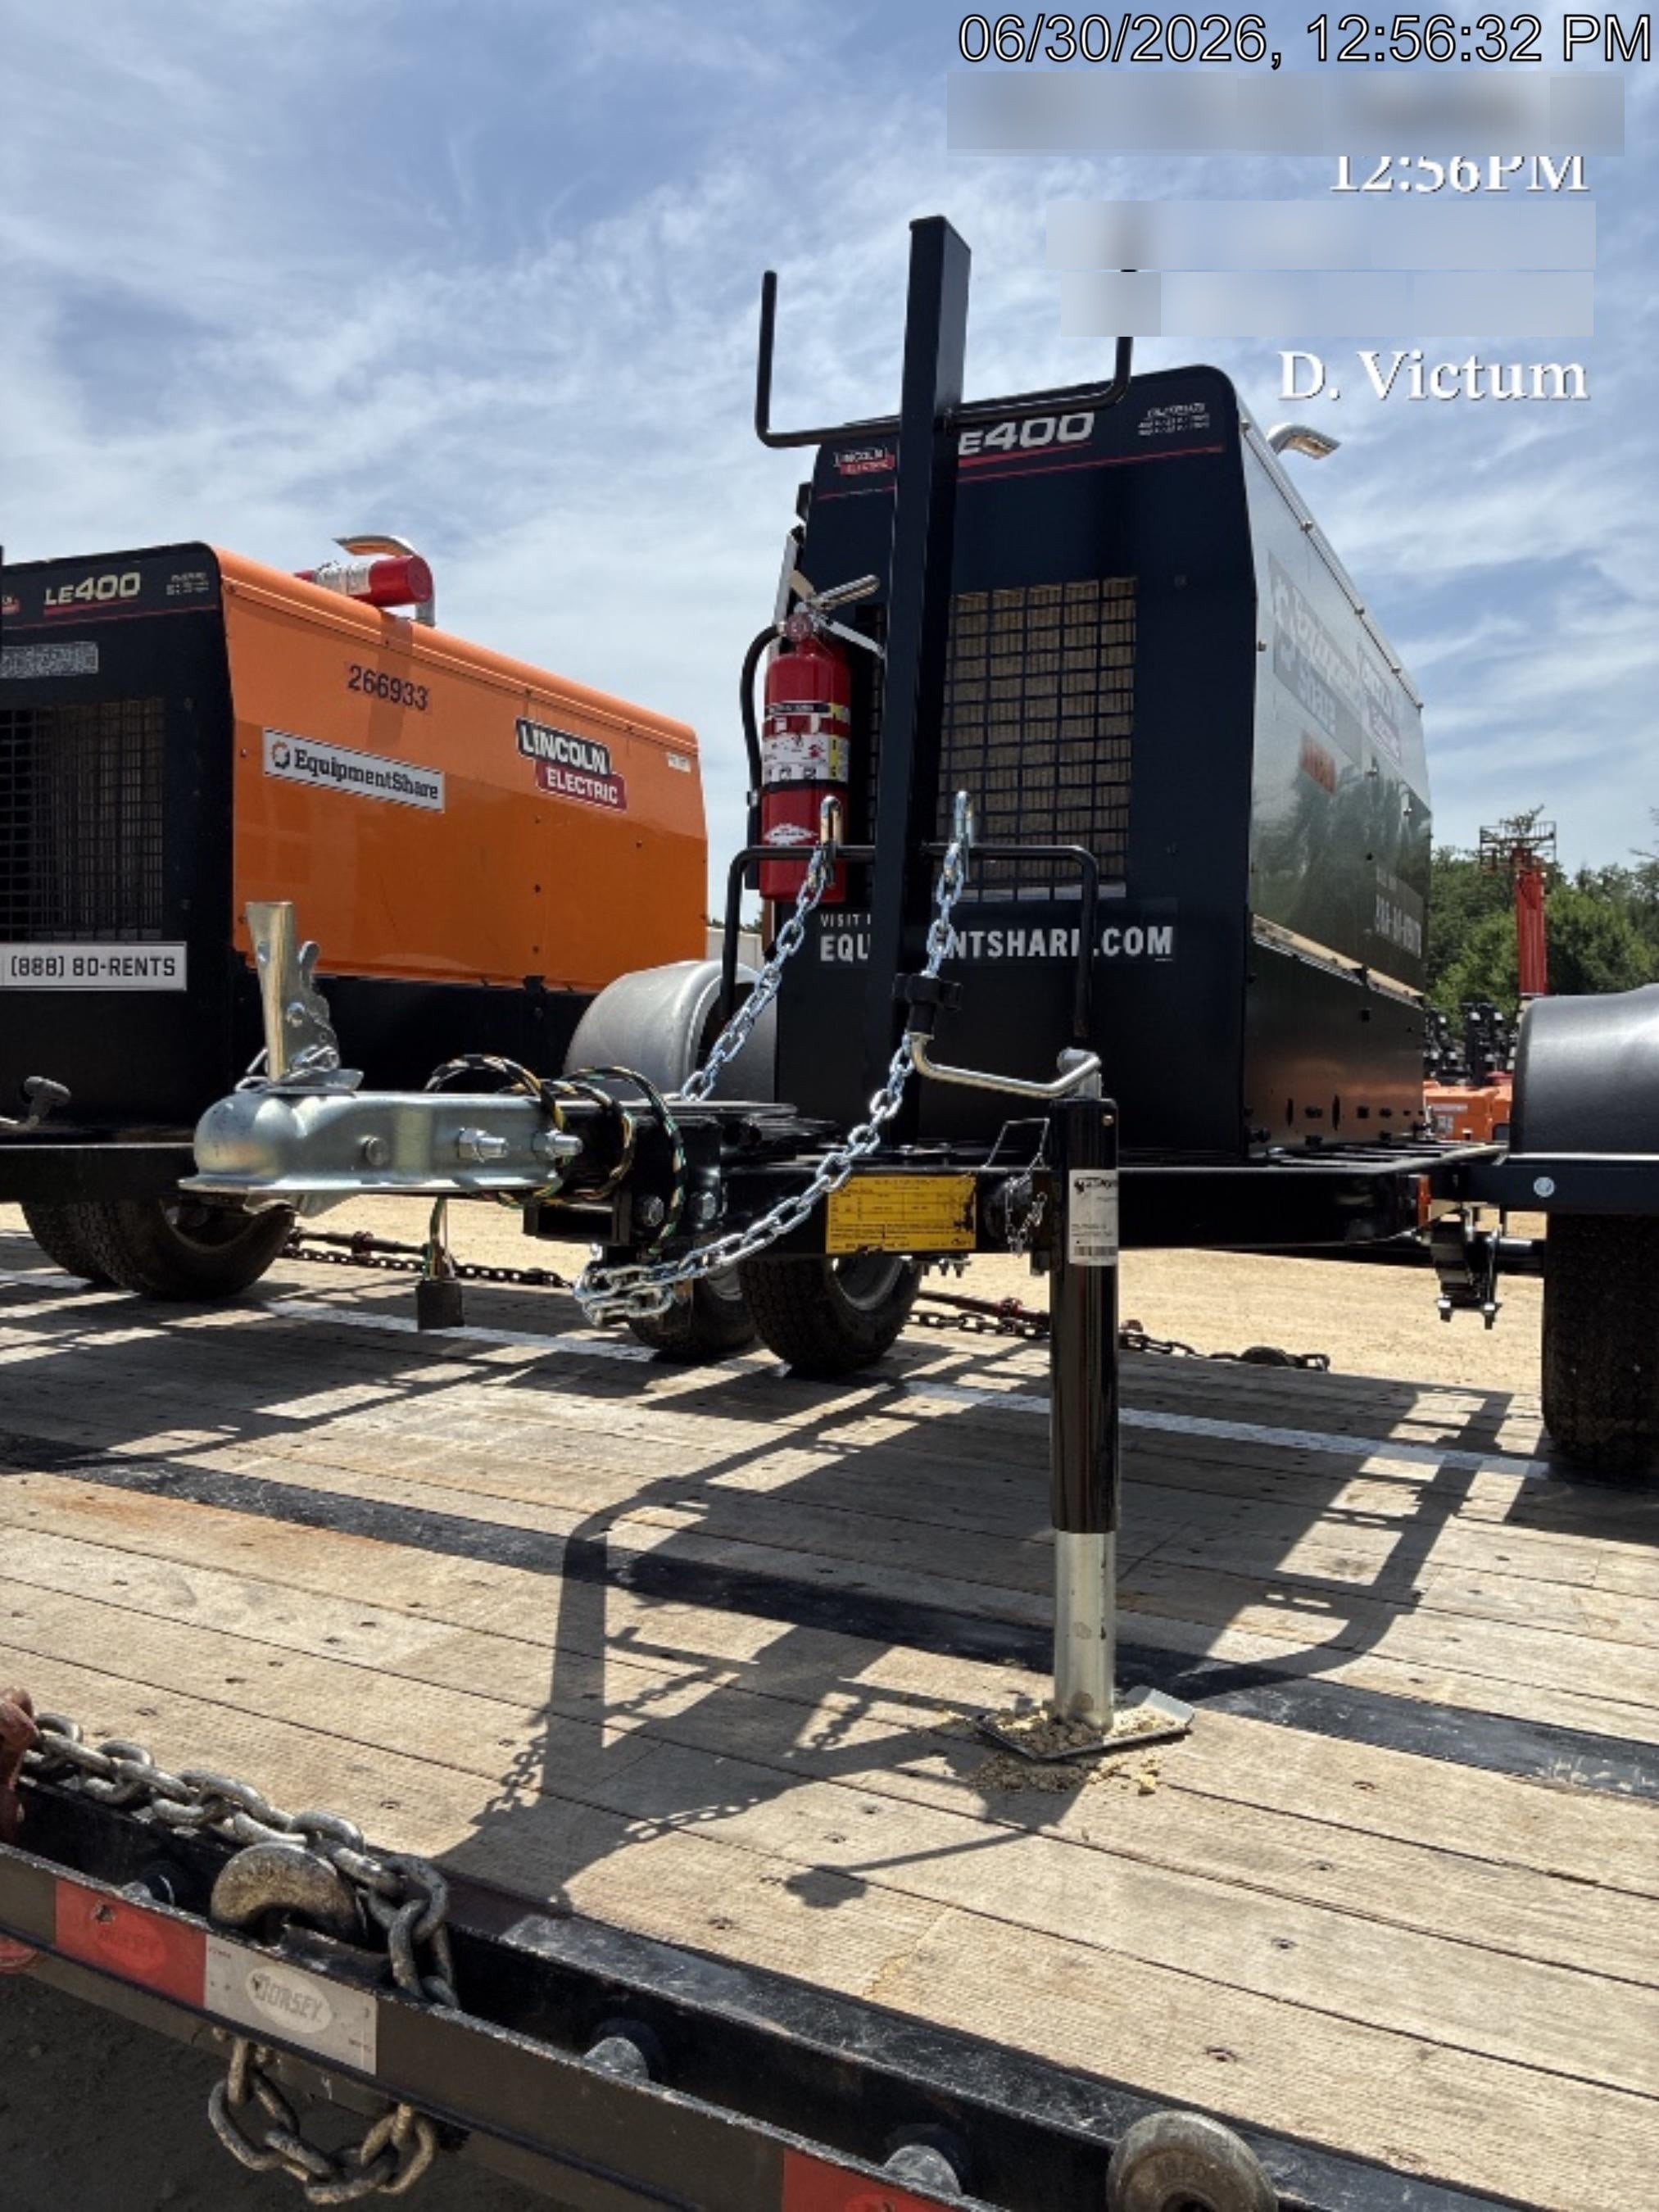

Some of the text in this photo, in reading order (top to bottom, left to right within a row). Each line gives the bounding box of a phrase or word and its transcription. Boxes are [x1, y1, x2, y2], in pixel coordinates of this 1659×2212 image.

[958, 411, 1095, 456] E400
[44, 572, 141, 605] LE400
[347, 663, 429, 711] 266933
[520, 723, 608, 774] LINCOLN
[293, 747, 439, 800] EquipmentShare
[546, 766, 619, 805] ELECTRIC
[820, 913, 862, 927] VISIT
[73, 957, 175, 977] 80-RENTS
